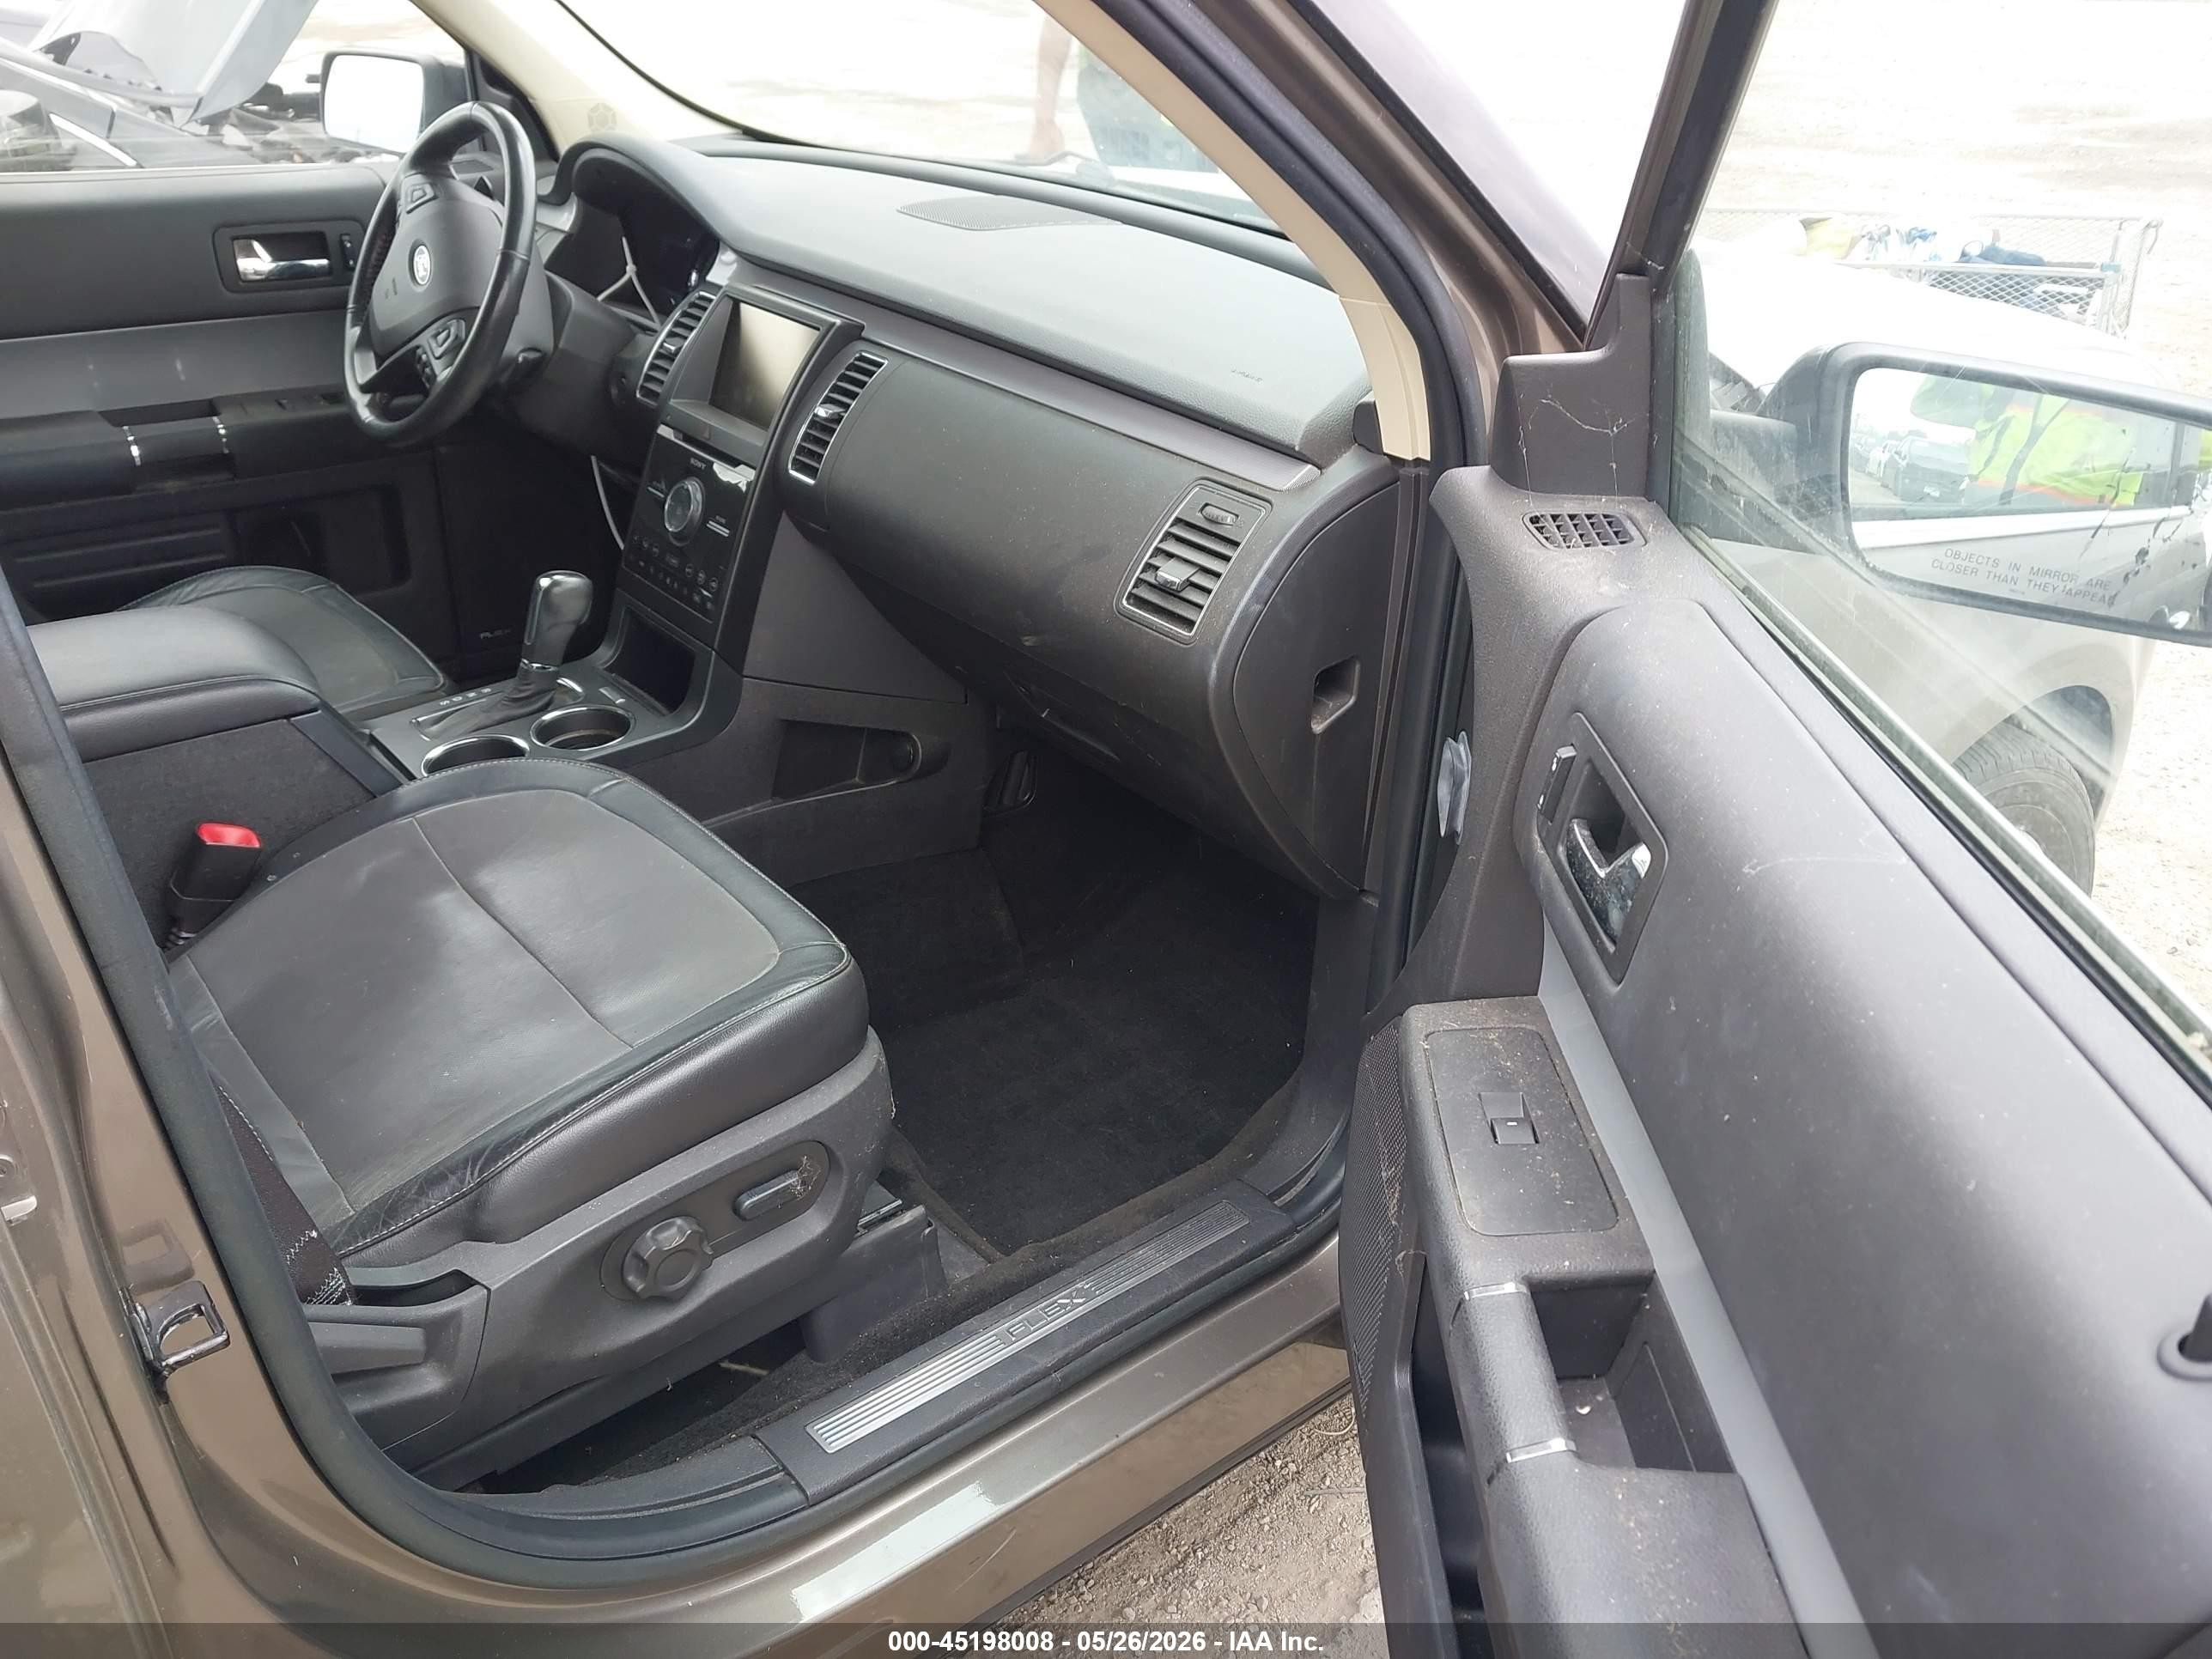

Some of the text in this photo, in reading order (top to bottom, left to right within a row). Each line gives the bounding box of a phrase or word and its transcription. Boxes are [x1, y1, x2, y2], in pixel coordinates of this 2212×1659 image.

[1931, 558, 1979, 578] CLOSER
[1986, 570, 2019, 586] THAN
[2027, 579, 2059, 594] THEY
[1944, 548, 2000, 568] OBJECTS
[2008, 562, 2021, 573] IN
[2086, 577, 2112, 591] ARE
[1003, 1290, 1086, 1341] FLEX
